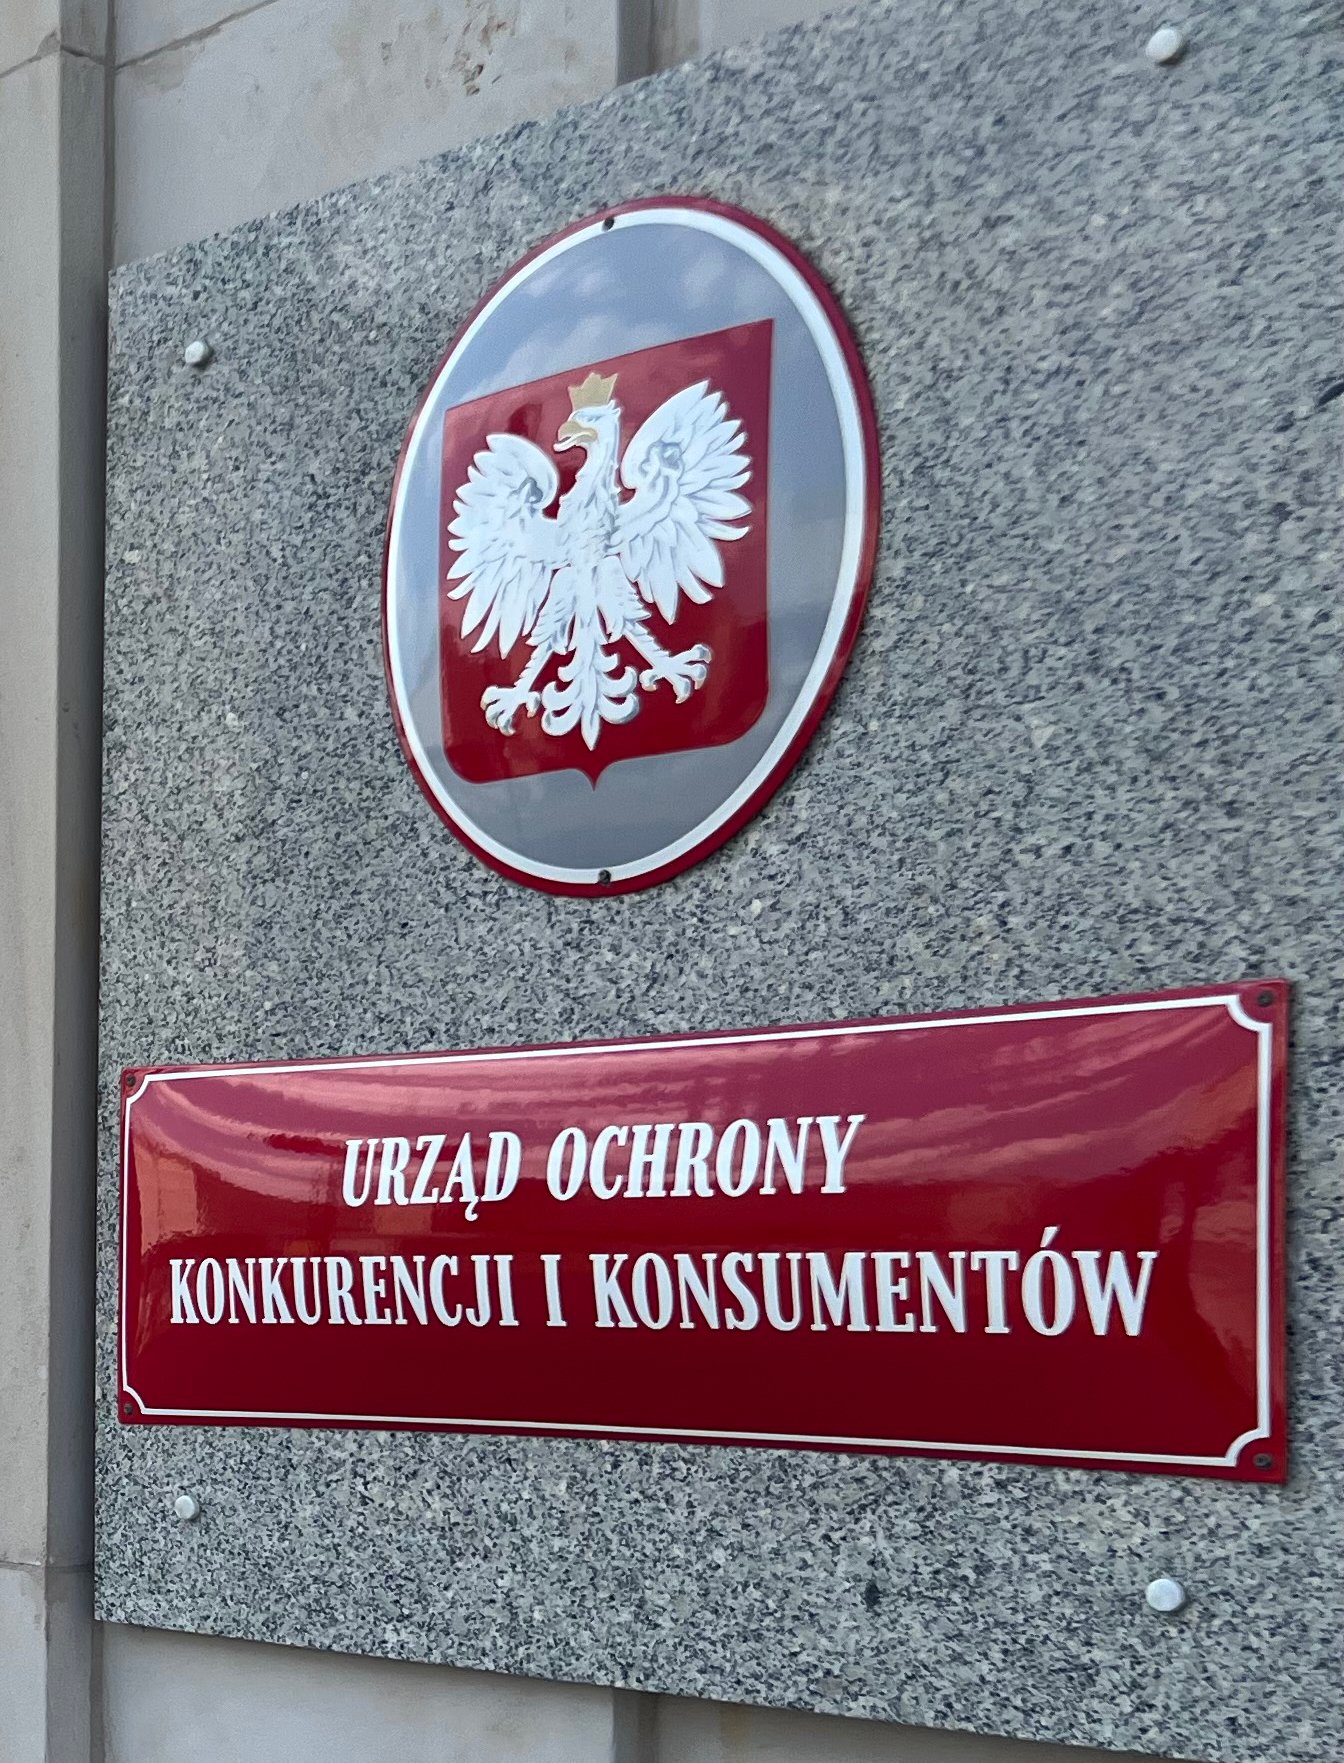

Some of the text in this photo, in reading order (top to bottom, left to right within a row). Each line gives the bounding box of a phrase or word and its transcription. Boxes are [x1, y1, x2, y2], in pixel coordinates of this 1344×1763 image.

[342, 1114, 868, 1223] URZĄD OCHRONY
[168, 1225, 1159, 1338] KONKURENCJI I KONSUMENTÓW
